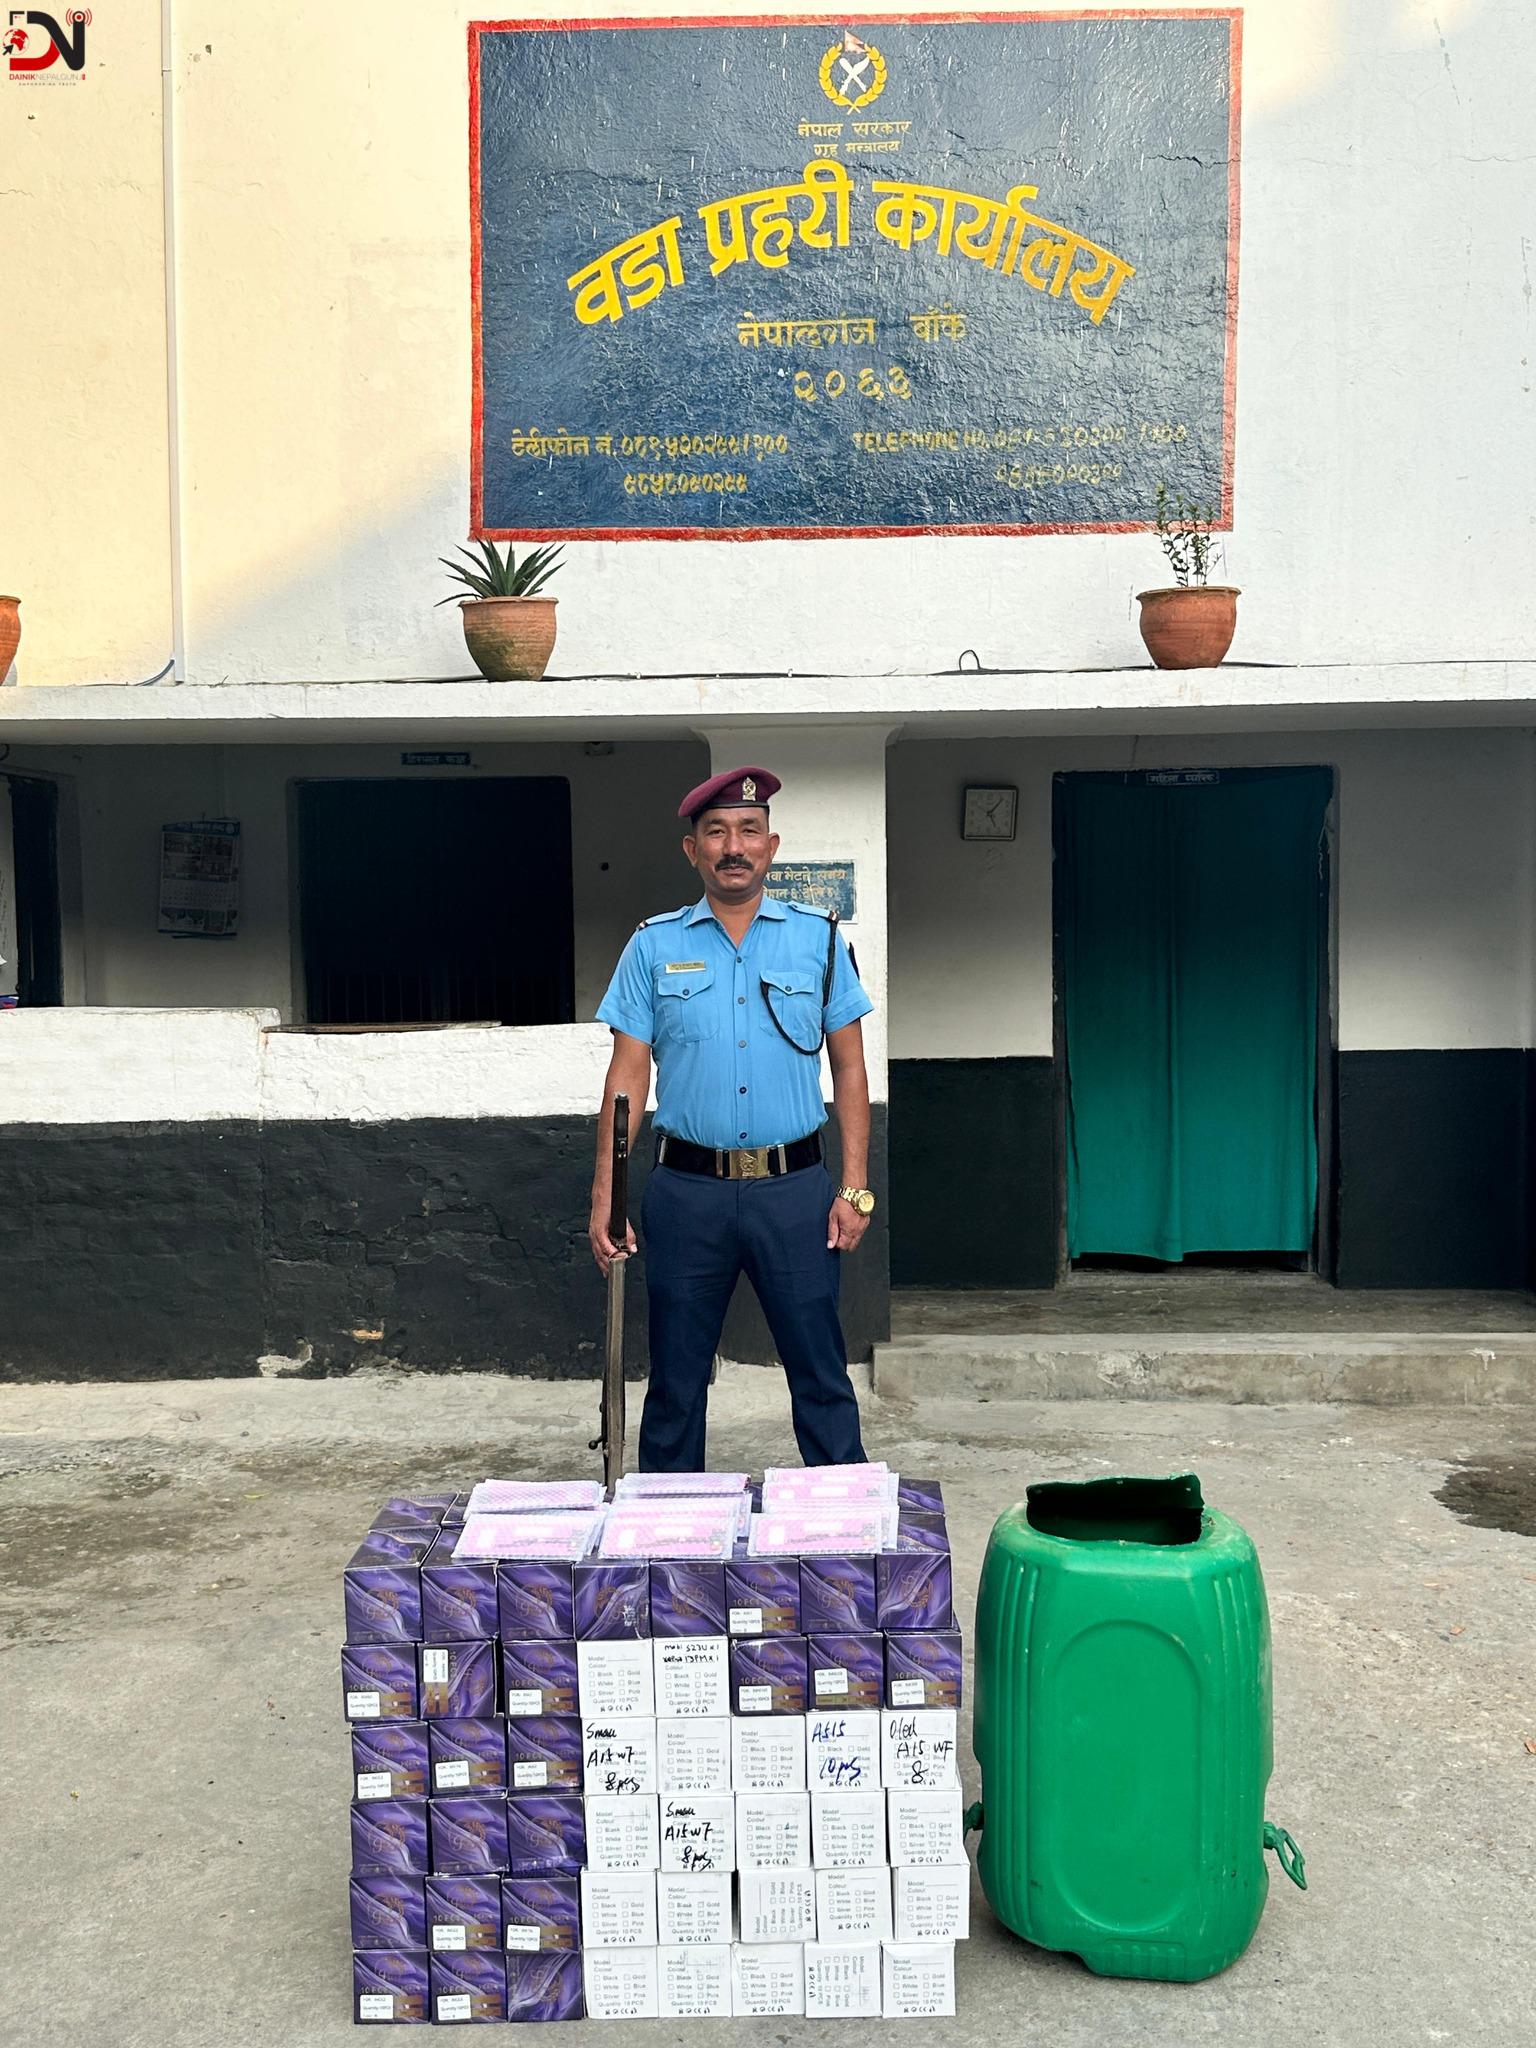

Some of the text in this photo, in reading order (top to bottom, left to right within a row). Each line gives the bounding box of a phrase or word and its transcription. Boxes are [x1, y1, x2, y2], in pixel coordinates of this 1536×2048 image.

[798, 117, 912, 139] नेपाल सरकार
[567, 160, 1137, 327] वडा प्रहरी कार्यालय
[736, 311, 877, 349] नेपालगंज
